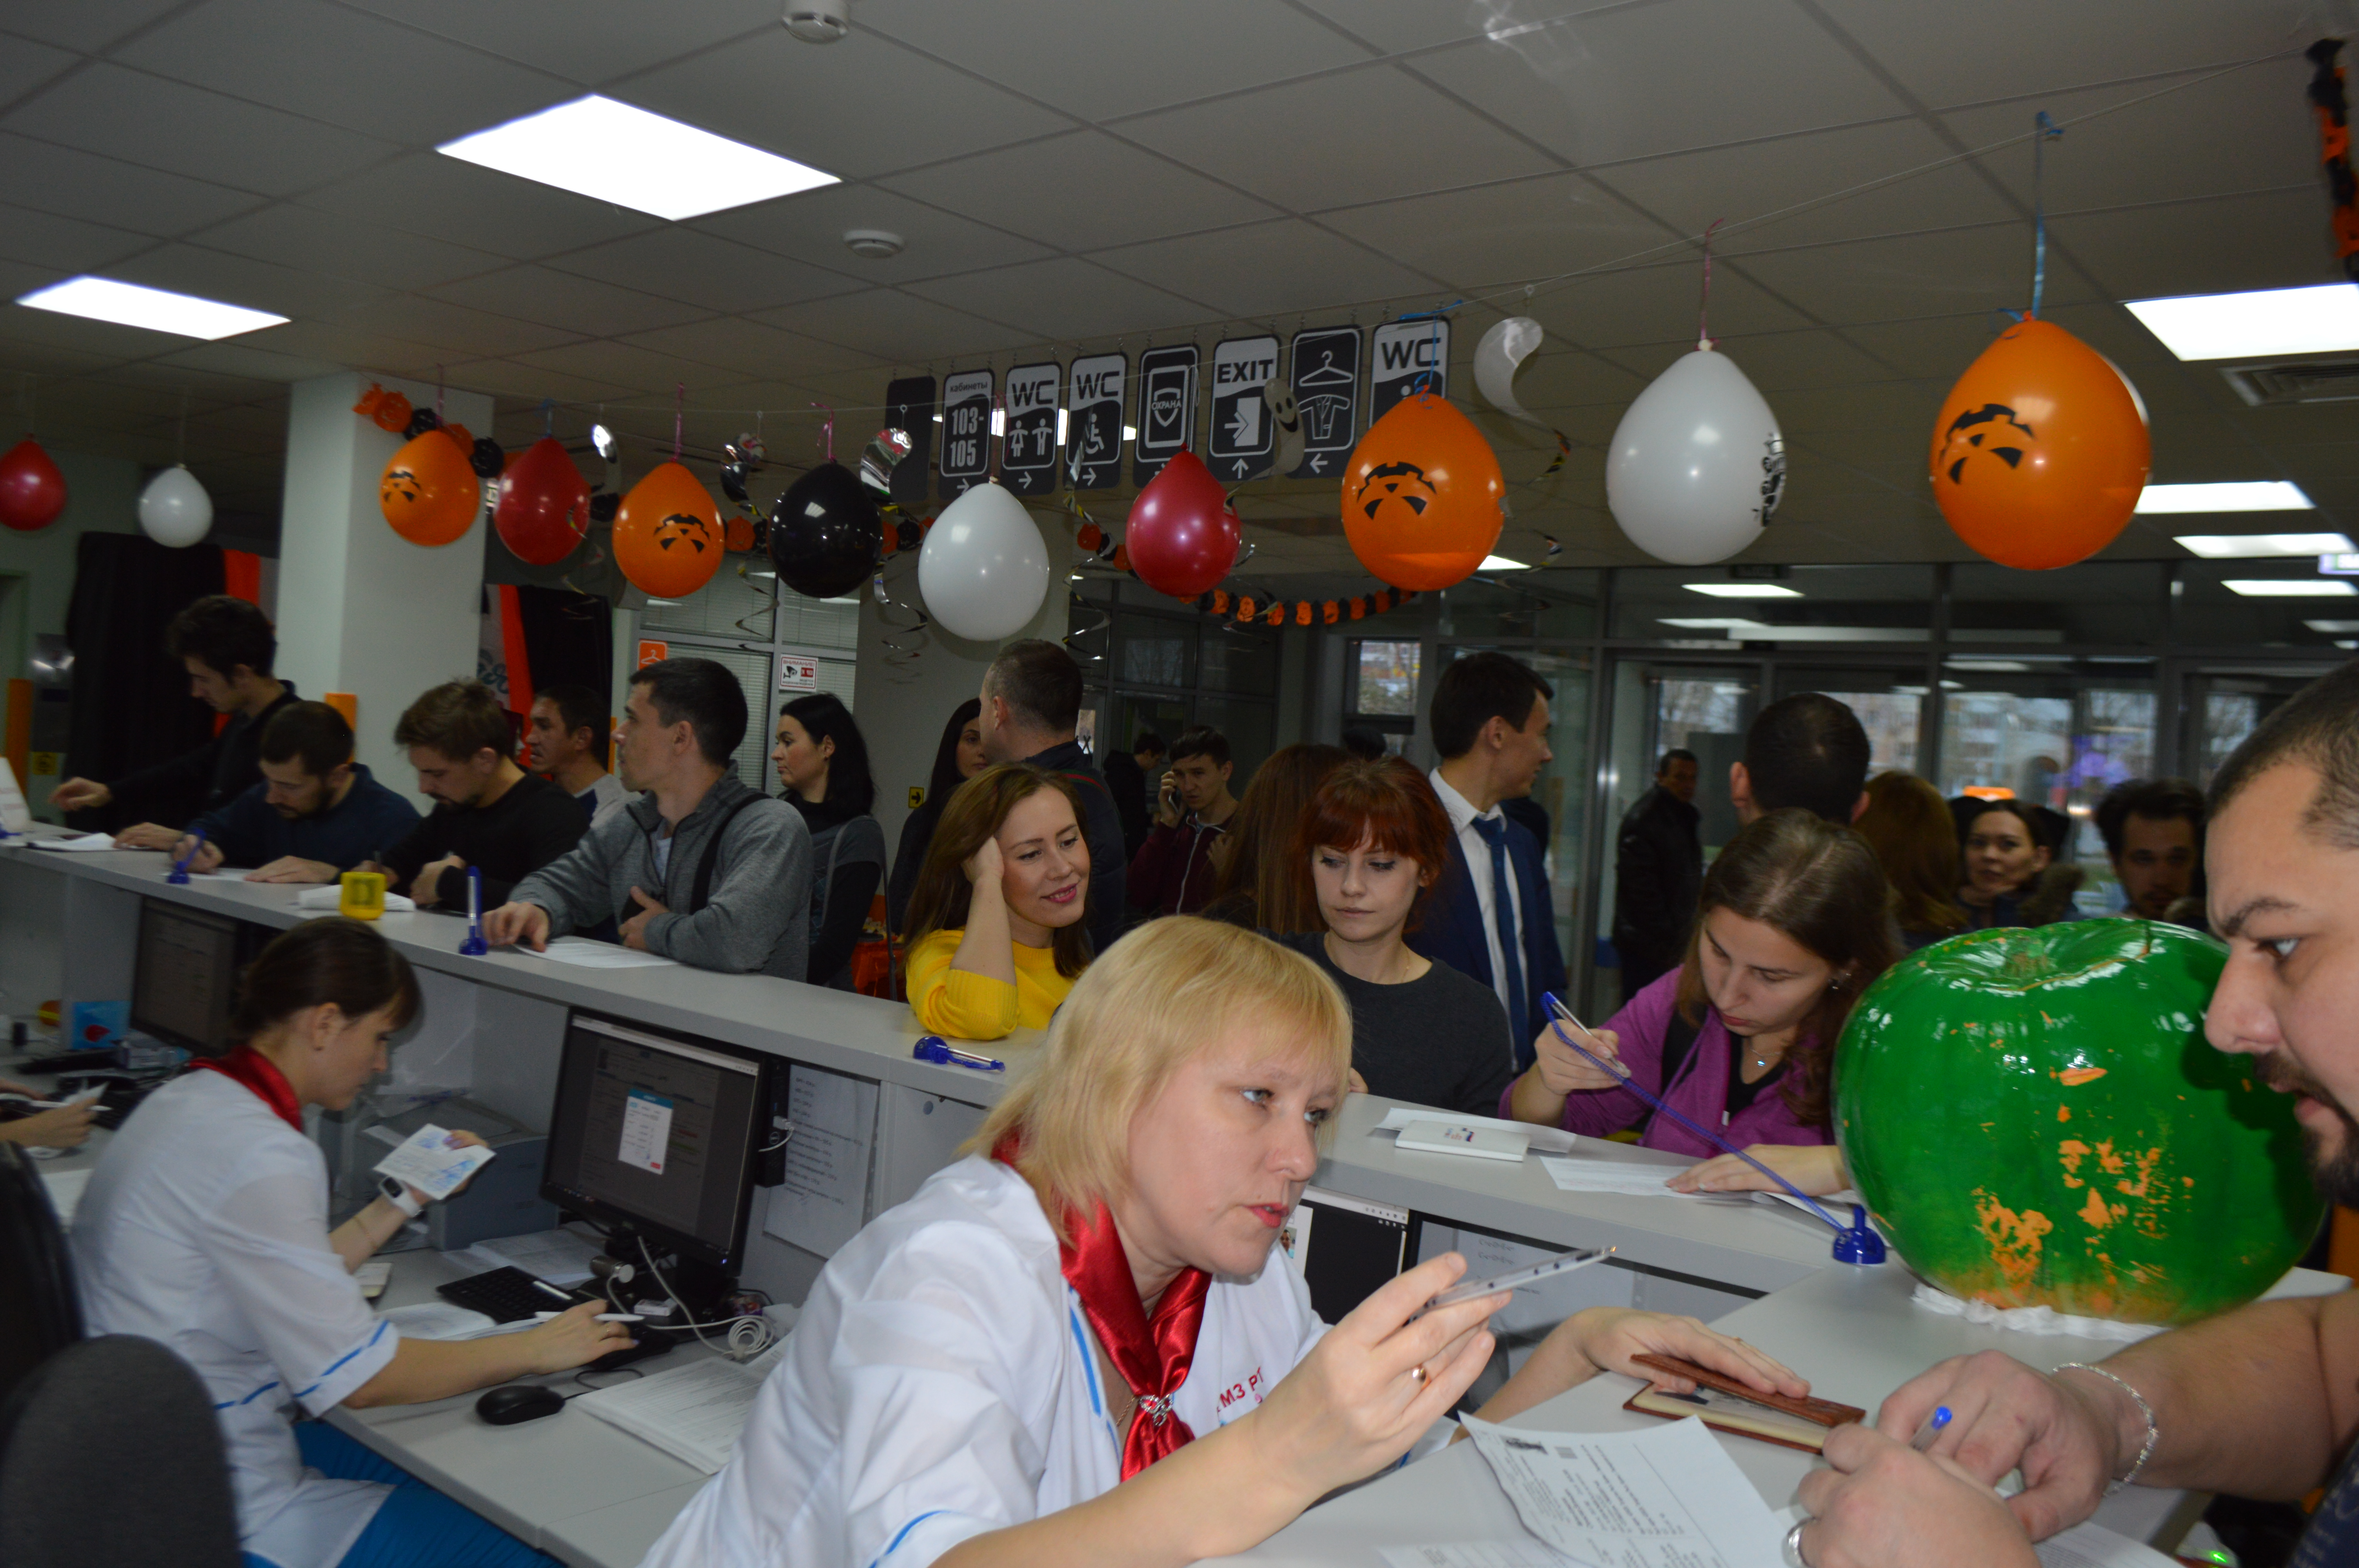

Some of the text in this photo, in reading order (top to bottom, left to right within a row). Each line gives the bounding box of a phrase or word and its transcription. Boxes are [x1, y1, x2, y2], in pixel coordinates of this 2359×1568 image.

[1381, 338, 1441, 370] WC
[1217, 359, 1273, 383] EXIT
[950, 382, 988, 392] кабинеты
[1012, 380, 1054, 407] WC
[1076, 371, 1120, 399] WC
[1151, 399, 1182, 410] ОХРАНА
[952, 406, 985, 436] 103-
[950, 439, 977, 468] 105
